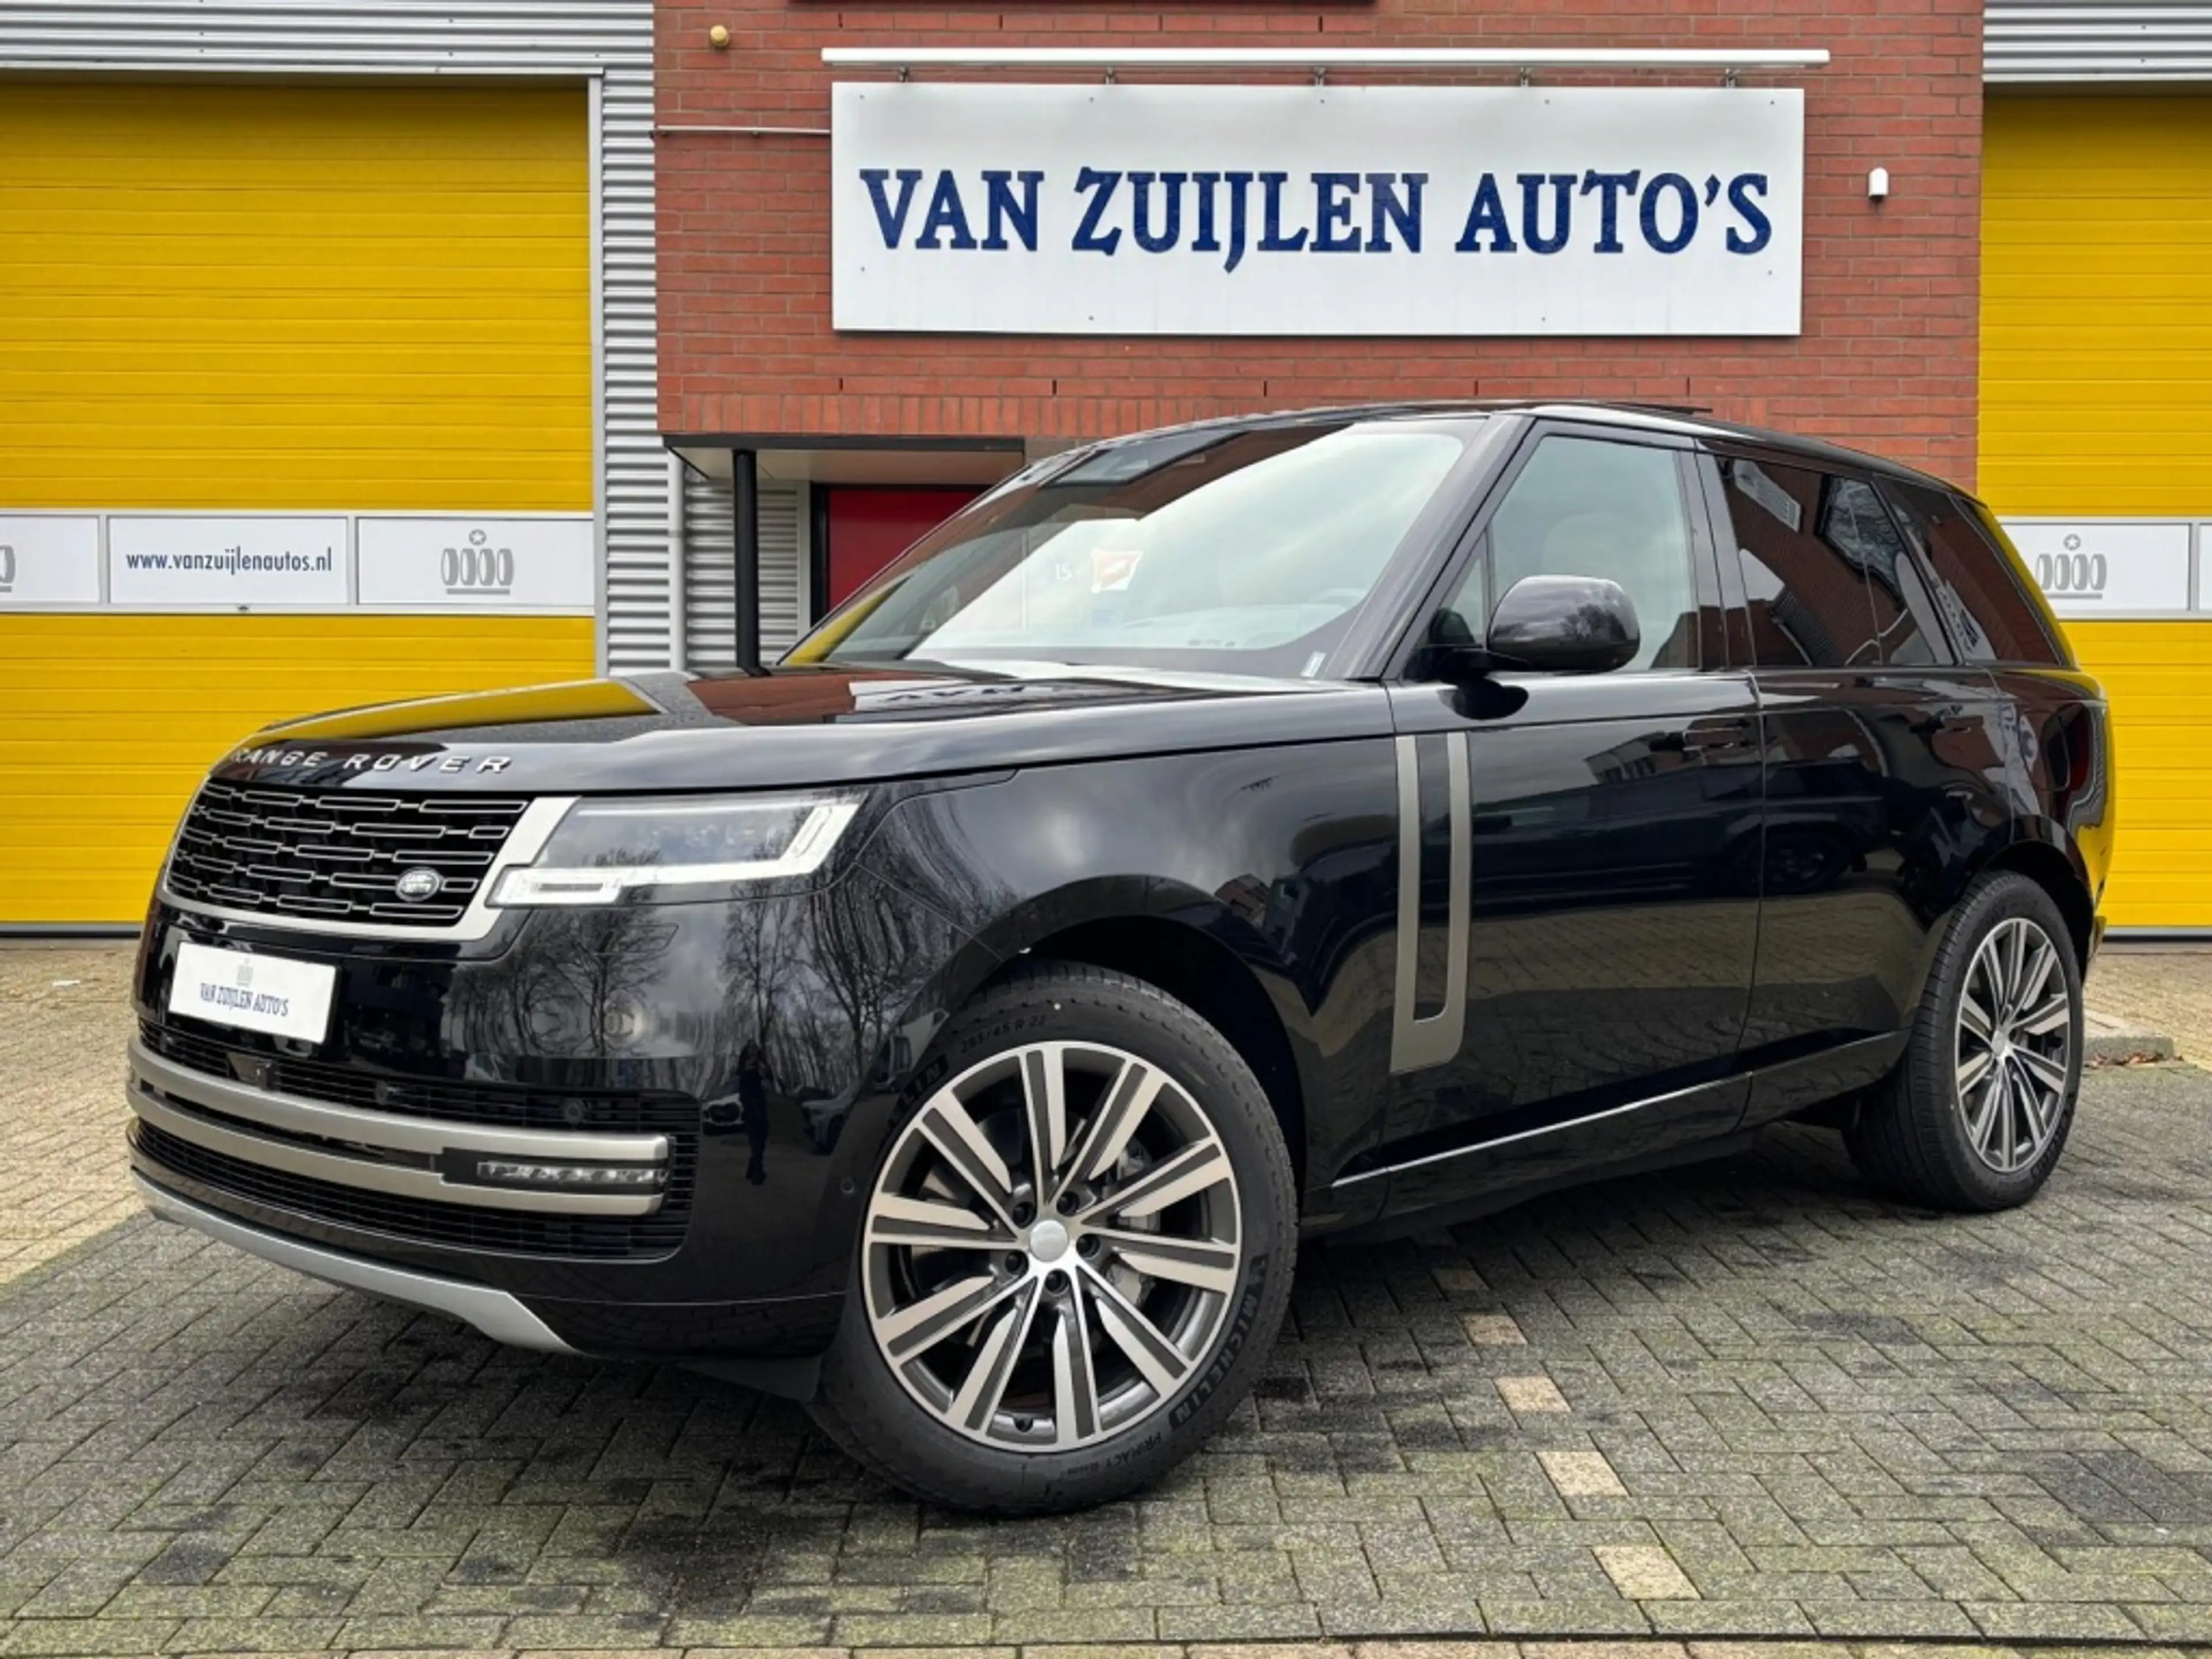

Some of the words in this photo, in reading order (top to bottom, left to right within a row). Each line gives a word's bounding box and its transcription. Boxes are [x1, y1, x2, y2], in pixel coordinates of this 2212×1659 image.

[860, 169, 1044, 252] VAN
[1071, 166, 1429, 274] ZUIJLEN
[1455, 169, 1773, 255] AUTO'S
[125, 545, 332, 576] www.vanzuijlenautos.nl
[343, 753, 512, 774] ROVER
[252, 993, 290, 1017] AUTO'S
[1175, 1292, 1259, 1423] MICHELIN
